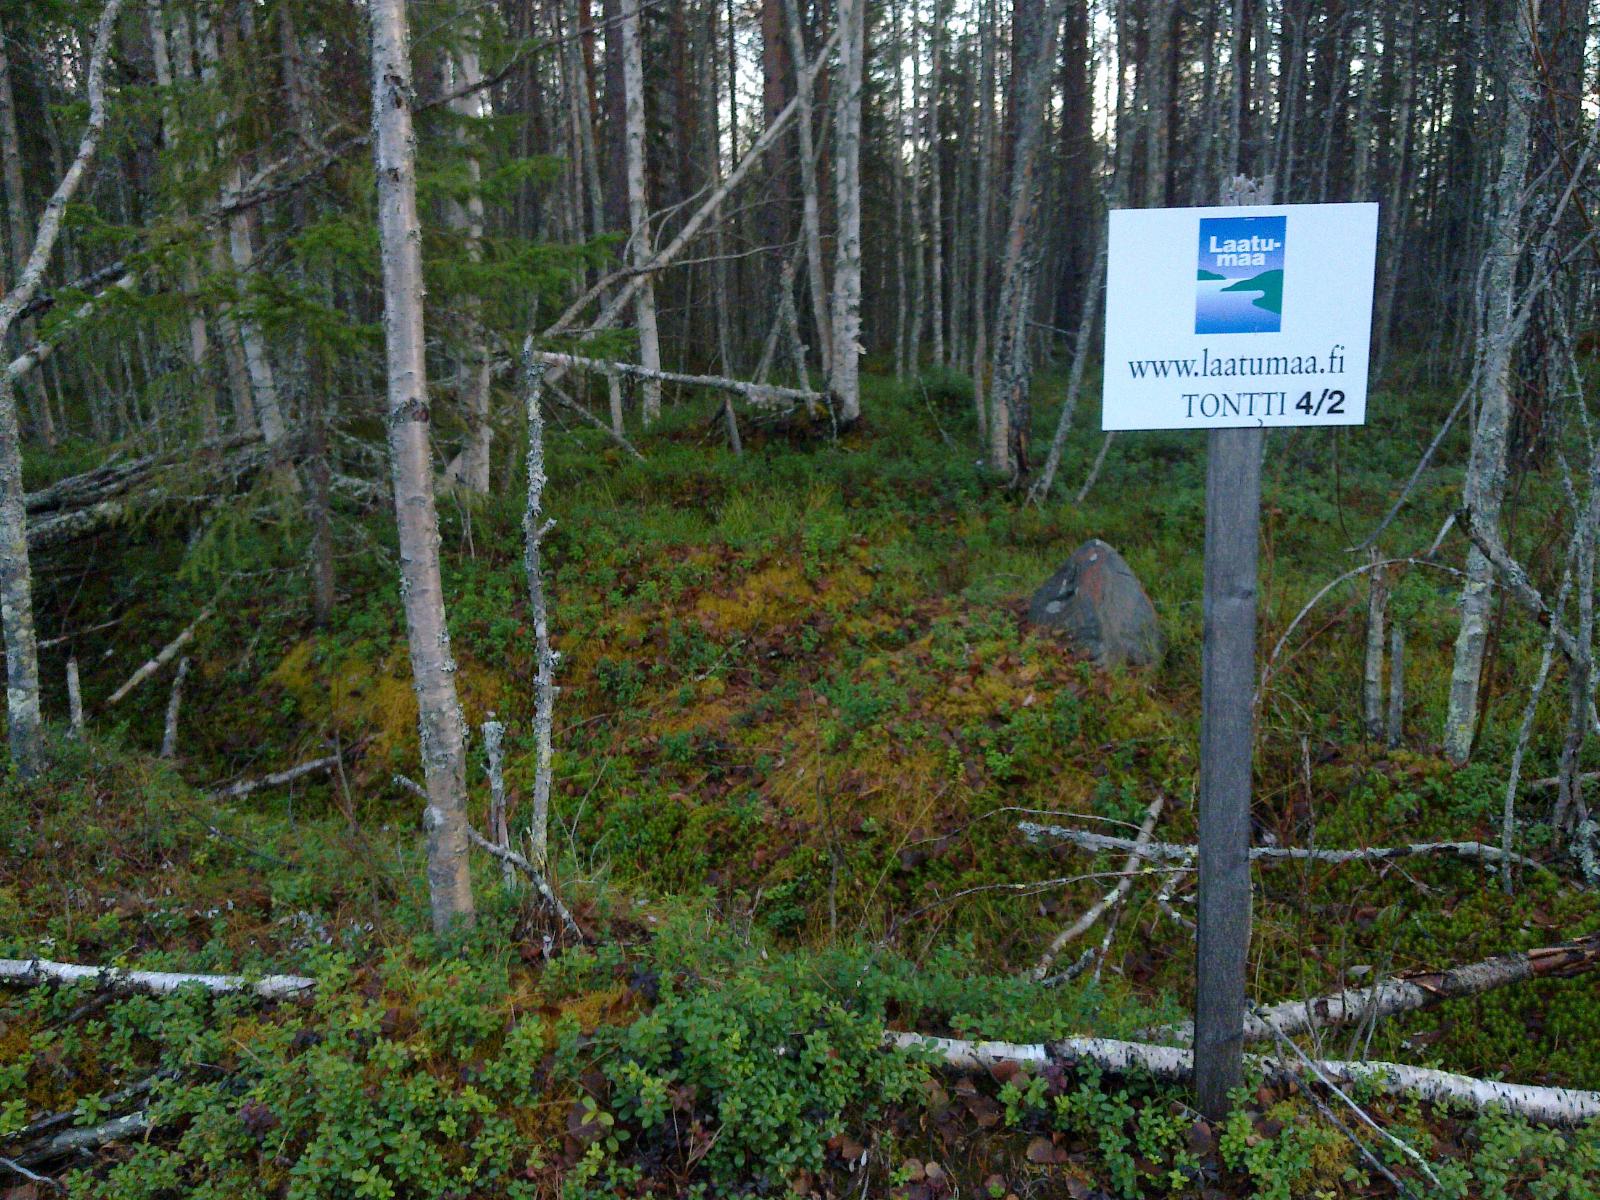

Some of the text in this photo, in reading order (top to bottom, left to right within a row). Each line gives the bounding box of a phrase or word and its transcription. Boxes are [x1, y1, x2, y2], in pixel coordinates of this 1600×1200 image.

[1209, 235, 1281, 253] Laatu-
[1216, 252, 1265, 267] maa
[1128, 345, 1345, 379] www.laatumaa.fi
[1182, 389, 1345, 418] TONTTI 4/2
